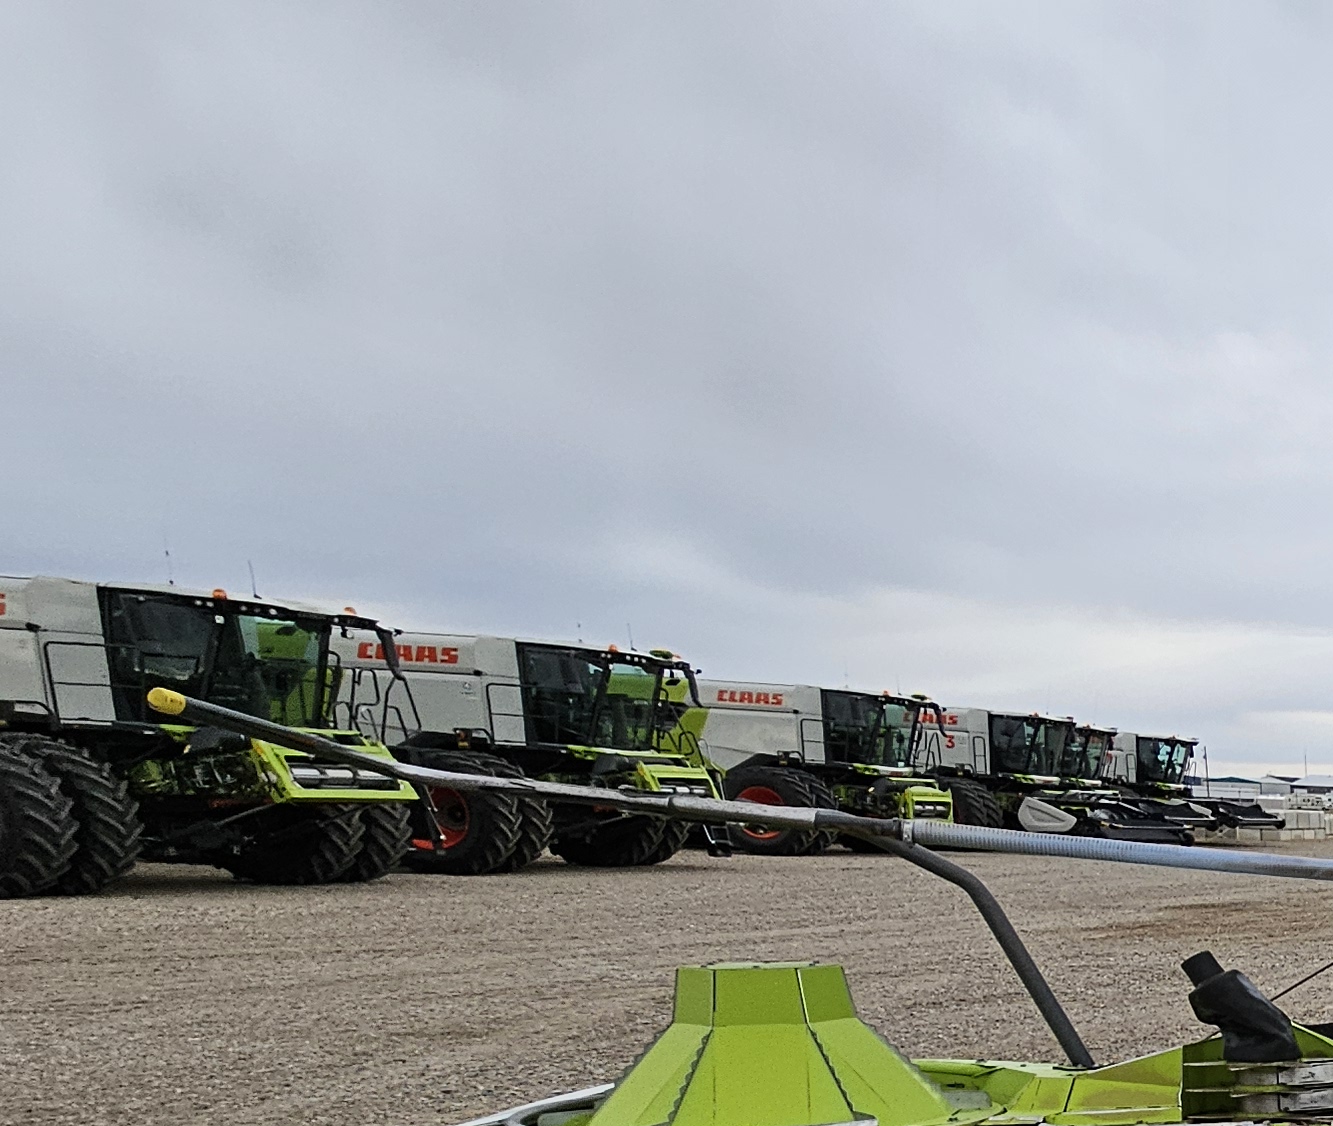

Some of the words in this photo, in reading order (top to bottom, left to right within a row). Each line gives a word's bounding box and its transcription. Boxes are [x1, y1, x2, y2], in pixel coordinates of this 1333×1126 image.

[357, 642, 458, 664] CLAAS
[717, 689, 783, 706] CLAAS
[903, 711, 958, 725] CAS
[946, 735, 955, 748] 3
